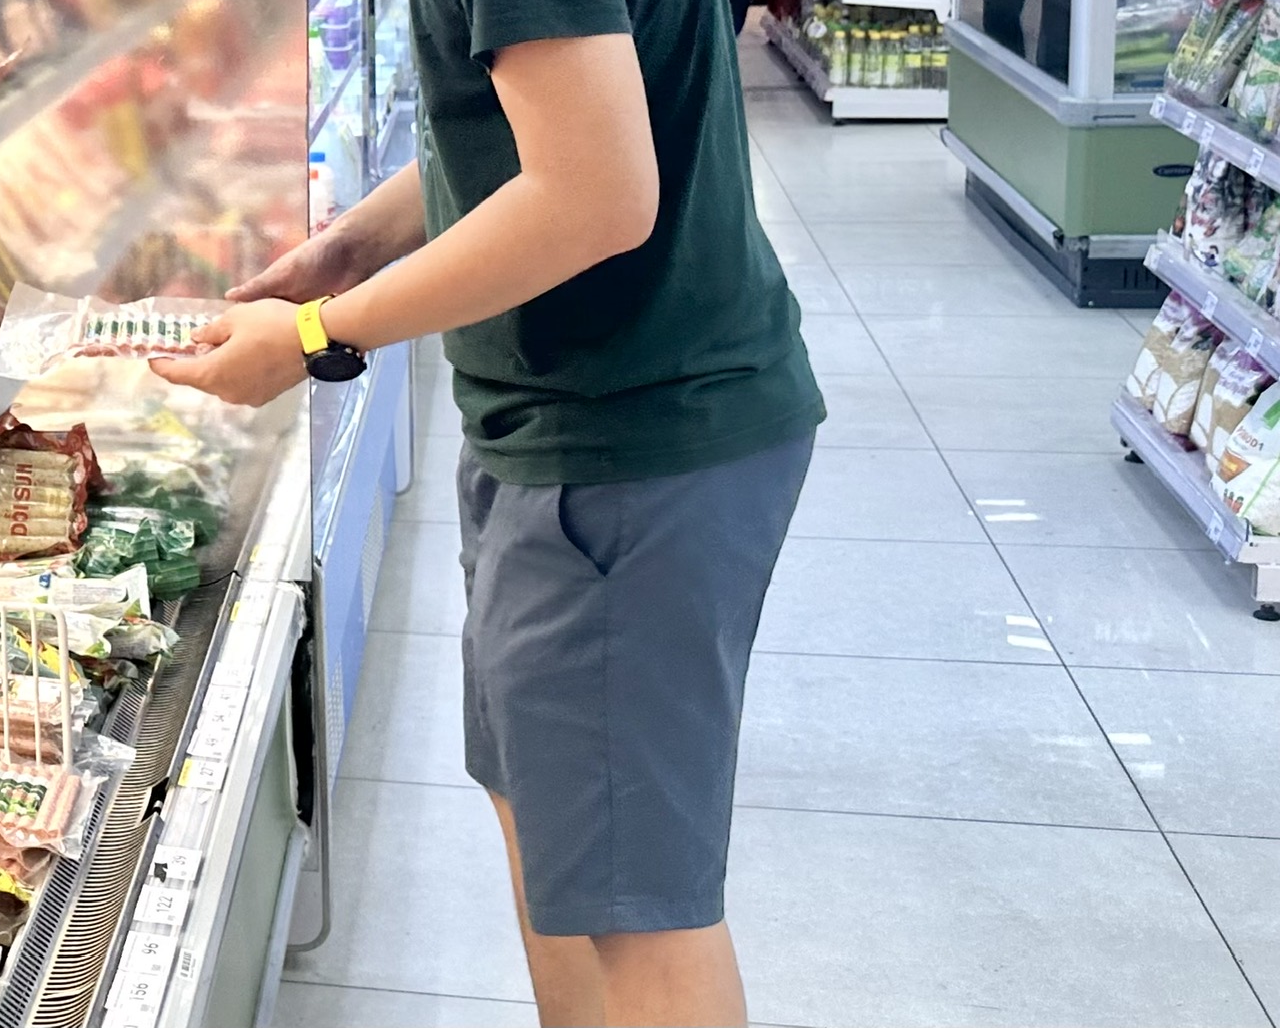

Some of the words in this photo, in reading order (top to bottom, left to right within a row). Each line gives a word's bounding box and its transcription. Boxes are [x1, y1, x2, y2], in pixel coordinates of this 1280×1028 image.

[156, 895, 173, 913] 122
[141, 942, 159, 955] 96
[129, 982, 149, 1000] 156
